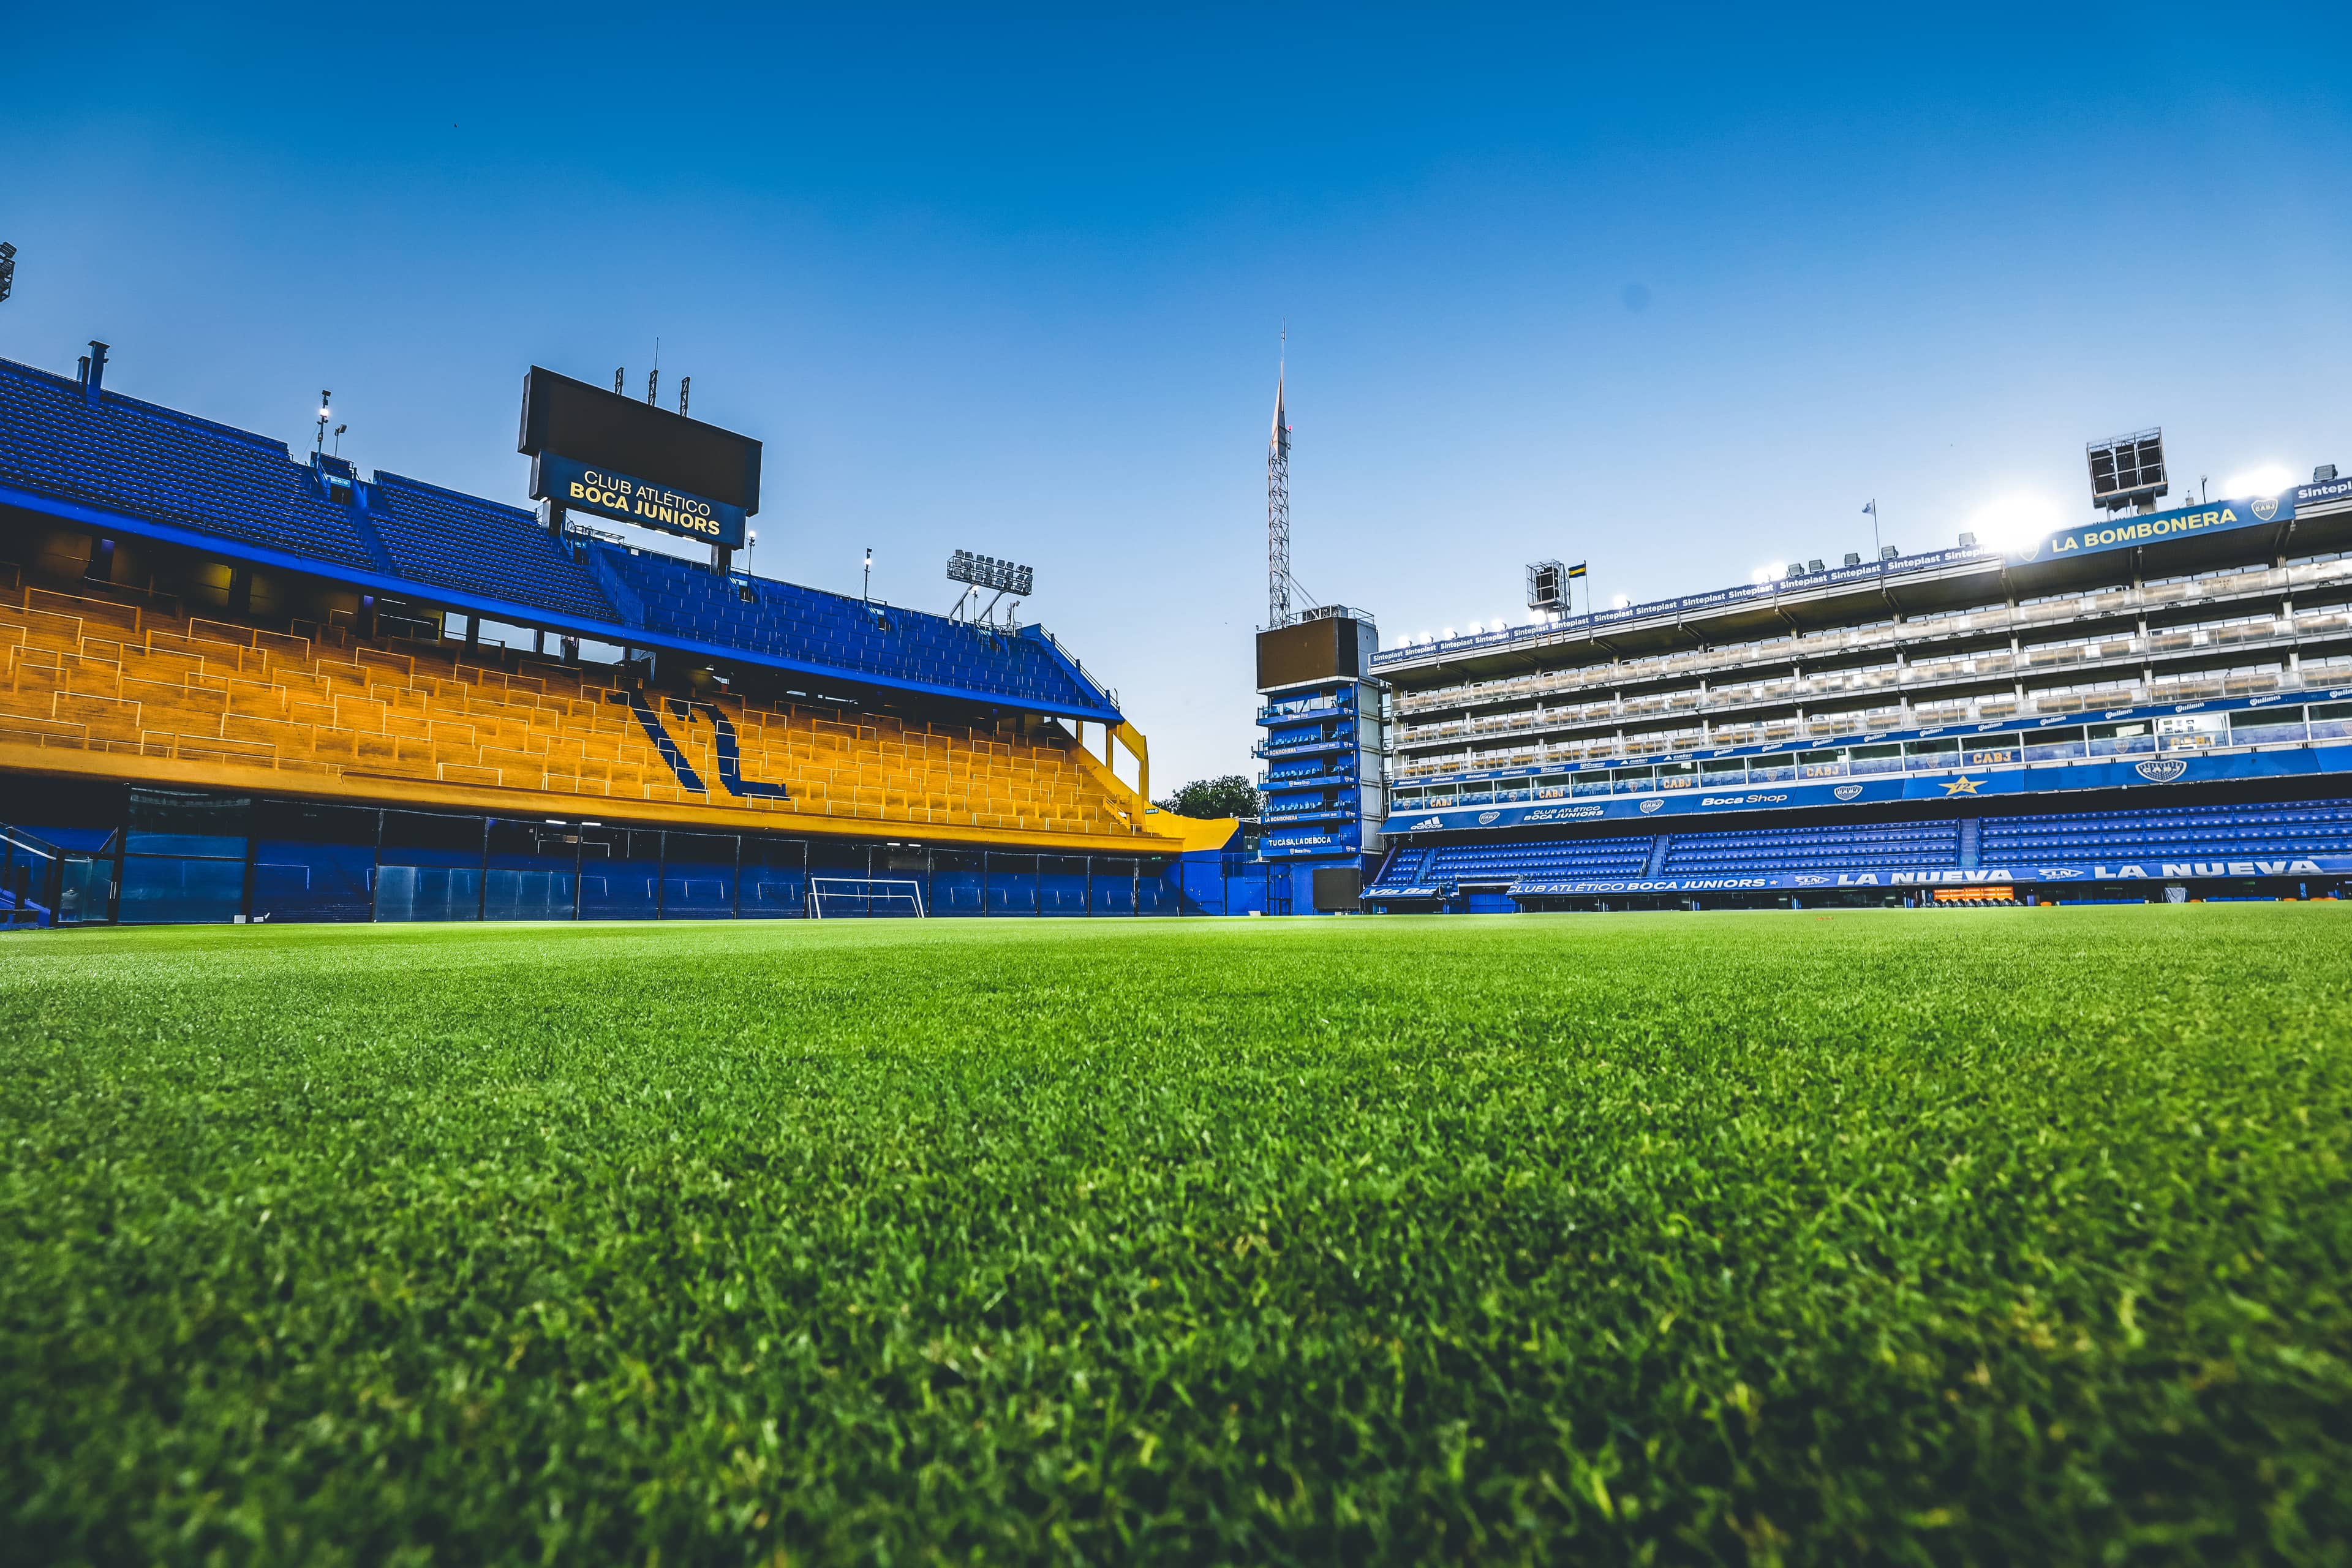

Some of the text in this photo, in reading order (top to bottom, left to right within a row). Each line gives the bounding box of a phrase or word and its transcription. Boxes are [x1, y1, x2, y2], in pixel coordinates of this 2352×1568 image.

[584, 470, 710, 516] CLUB ATLÉTICO
[570, 481, 720, 535] BOCA JUNIORS
[2052, 508, 2237, 552] LA BOMBONERA
[1373, 546, 1994, 662] Sinteplast Sinteplast Sinteplast Sinteplast Sinteplast Sinteplast Sinteplast Sinteplast Sinteplast Sinteplast Sinteplast Sinteplast Sinteplast Sintepl
[1973, 751, 2011, 764] CABJ
[1807, 766, 1839, 777] CABJ
[1663, 778, 1692, 789] CABJ
[1539, 790, 1564, 799] CABJ
[1702, 794, 1788, 806] Boca Shop
[1430, 798, 1452, 808] CABJ
[1556, 805, 1600, 814] ATLÉTICO
[1555, 810, 1604, 819] JUNIORS
[2094, 861, 2323, 879] LA NUEVA
[1837, 869, 2015, 886] LA NUEVA
[1509, 878, 1766, 894] CLUB ATLÉTICO BOCA JUNIORS
